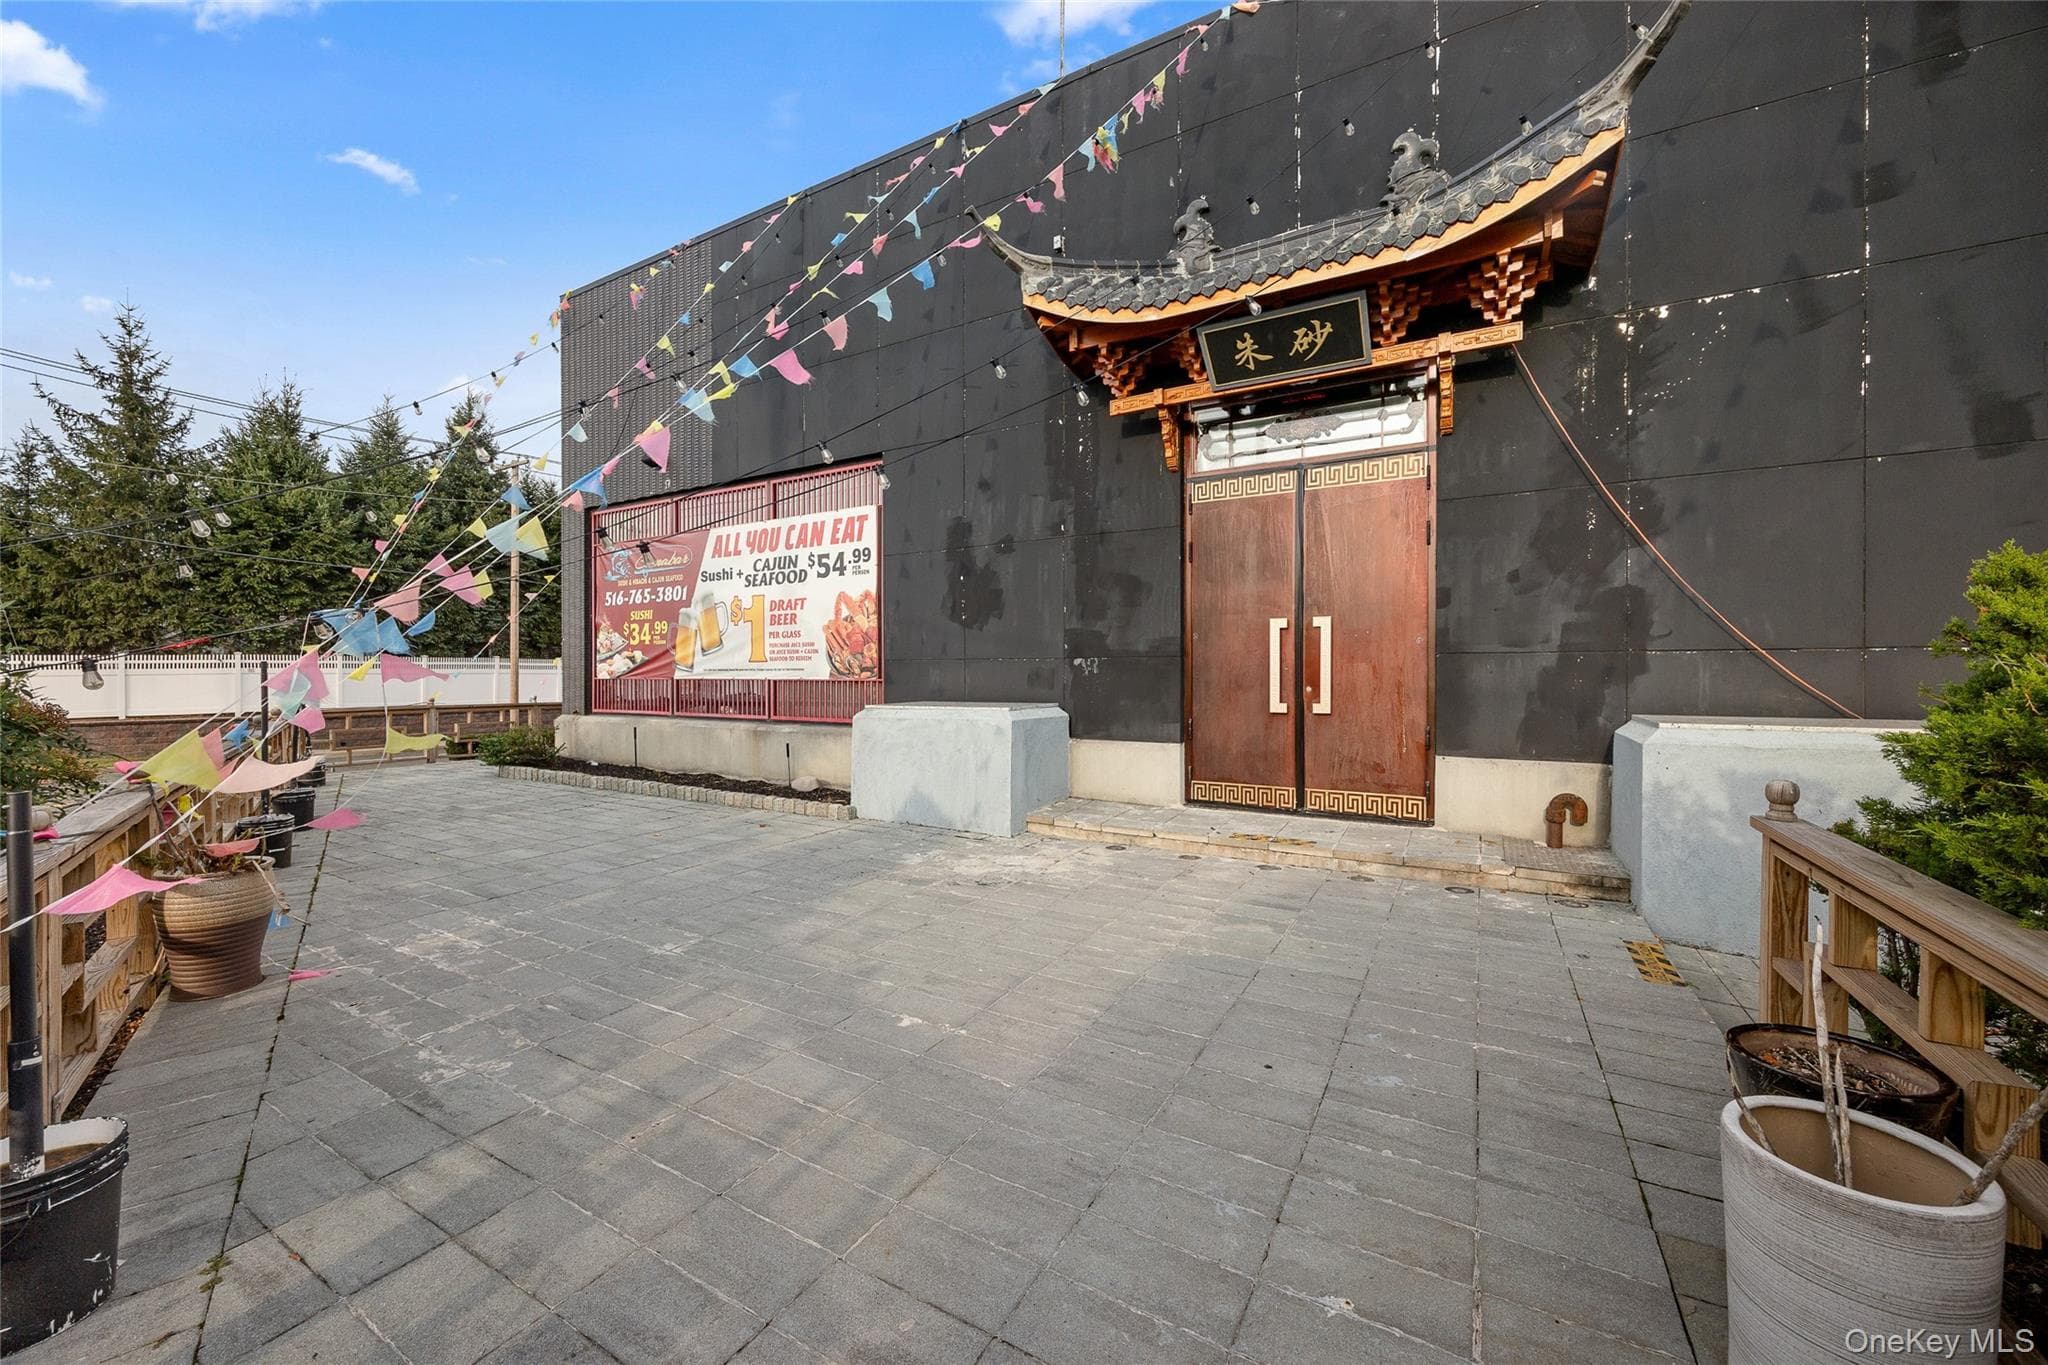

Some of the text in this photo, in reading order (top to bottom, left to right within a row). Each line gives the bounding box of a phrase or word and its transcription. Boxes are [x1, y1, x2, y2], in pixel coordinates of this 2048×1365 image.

[1234, 319, 1334, 371] 朱砂
[711, 514, 869, 559] ALL YOU CAN EAT
[753, 554, 799, 573] CAJUN
[808, 547, 872, 579] $54.99
[700, 567, 733, 583] Sushi
[744, 568, 808, 588] SEAFOOD
[604, 585, 688, 607] 516-765-3801
[769, 597, 807, 612] DRAFT
[630, 609, 654, 620] SUSHI
[769, 613, 798, 627] BEER
[623, 620, 668, 646] $34.99
[730, 594, 768, 663] $1
[768, 630, 801, 639] PER GLASS
